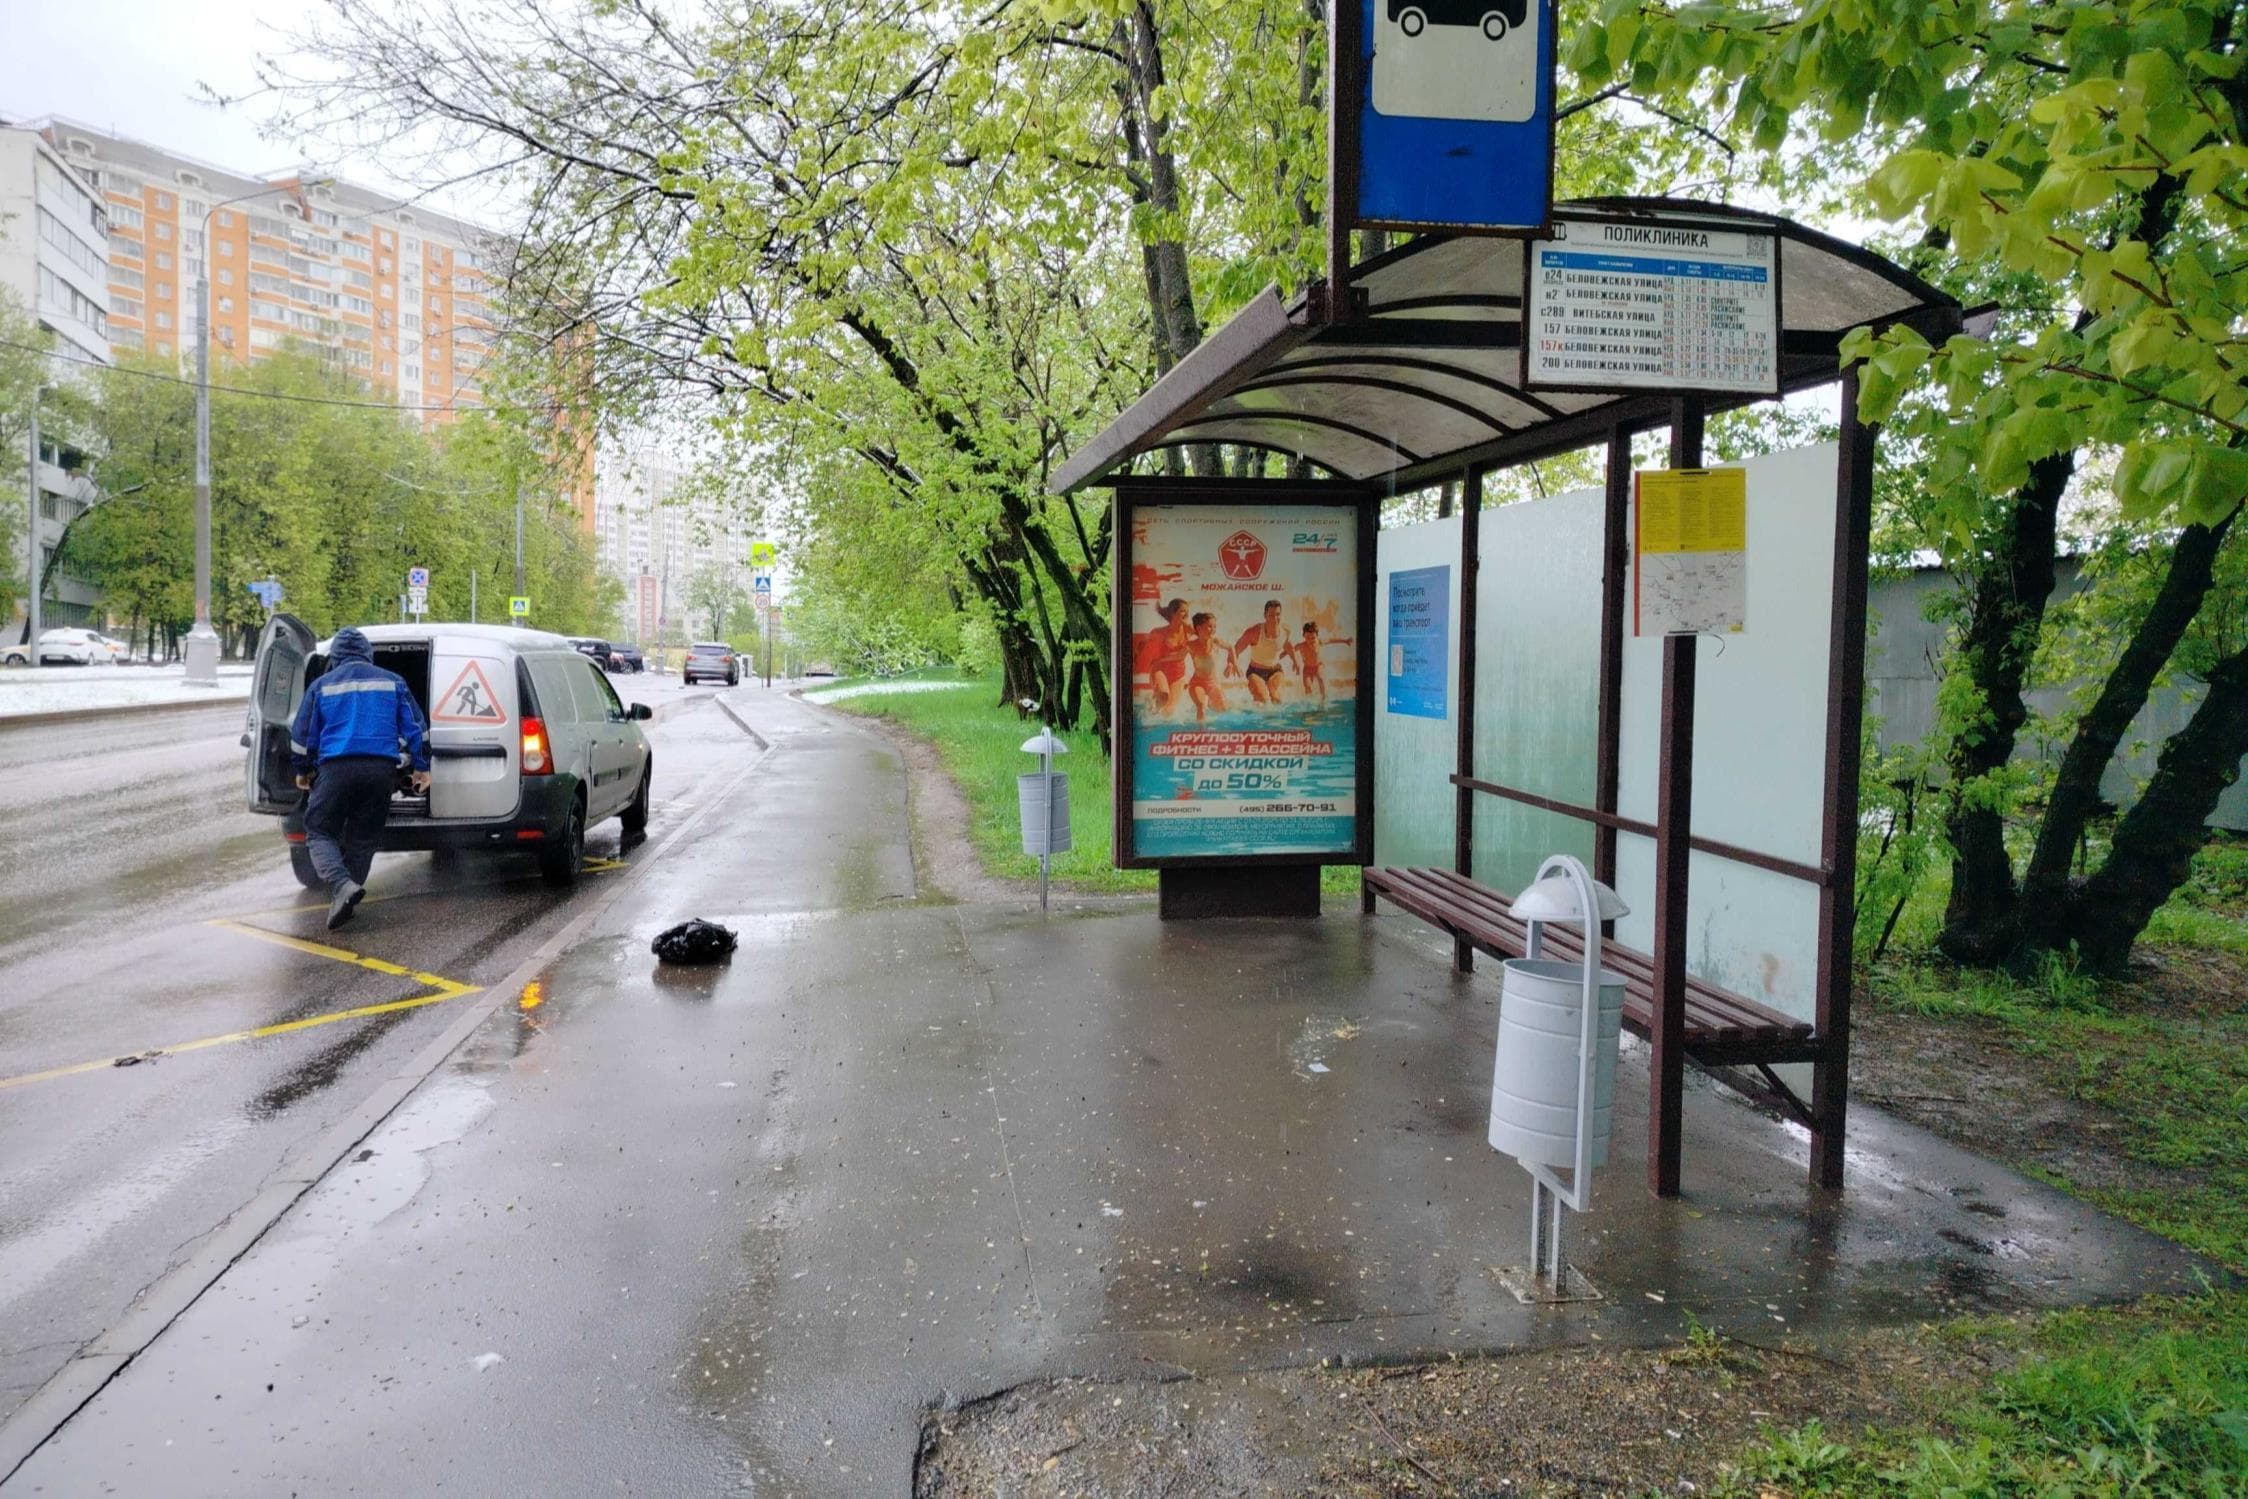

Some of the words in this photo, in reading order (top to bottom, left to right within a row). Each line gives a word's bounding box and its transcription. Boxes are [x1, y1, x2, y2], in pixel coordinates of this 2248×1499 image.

[1604, 226, 1709, 248] ПОЛИКЛИНИКА
[1566, 274, 1631, 286] БЕЛОВЕЖСКАЯ
[1634, 278, 1663, 289] УЛИЦА
[1566, 289, 1631, 301] БЕЛОВЕЖСКАЯ
[1634, 293, 1663, 304] УЛИЦА
[1573, 308, 1624, 320] ВИТЕБСКАЯ
[1626, 312, 1655, 323] УЛИЦА
[1544, 323, 1561, 334] 157
[1565, 325, 1631, 337] БЕЛОВЕЖСКАЯ
[1633, 328, 1662, 340] УЛИЦА
[1541, 340, 1564, 352] 157к
[1564, 342, 1631, 354] БЕЛОВЕЖСКАЯ
[1633, 345, 1662, 356] УЛИЦА
[1564, 359, 1630, 371] БЕЛОВЕЖСКАЯ
[1632, 362, 1662, 373] УЛИЦА
[1228, 537, 1257, 548] СССР
[1292, 533, 1338, 549] 24/7
[1200, 583, 1268, 592] МОЖАЙСКОЕ
[1270, 583, 1285, 592] Ш.
[1171, 732, 1311, 743] КРУГЛОСУТОЧНЫЙ
[1152, 744, 1218, 755] ФИТНЕС
[1221, 746, 1232, 754] +
[1248, 742, 1332, 755] БАССЕЙНА
[1177, 758, 1205, 770] СО
[1209, 755, 1304, 771] СКИДКОЙ
[1226, 774, 1282, 789] 50%
[1239, 805, 1265, 814] (495)
[1266, 803, 1337, 813] 266-70-91
